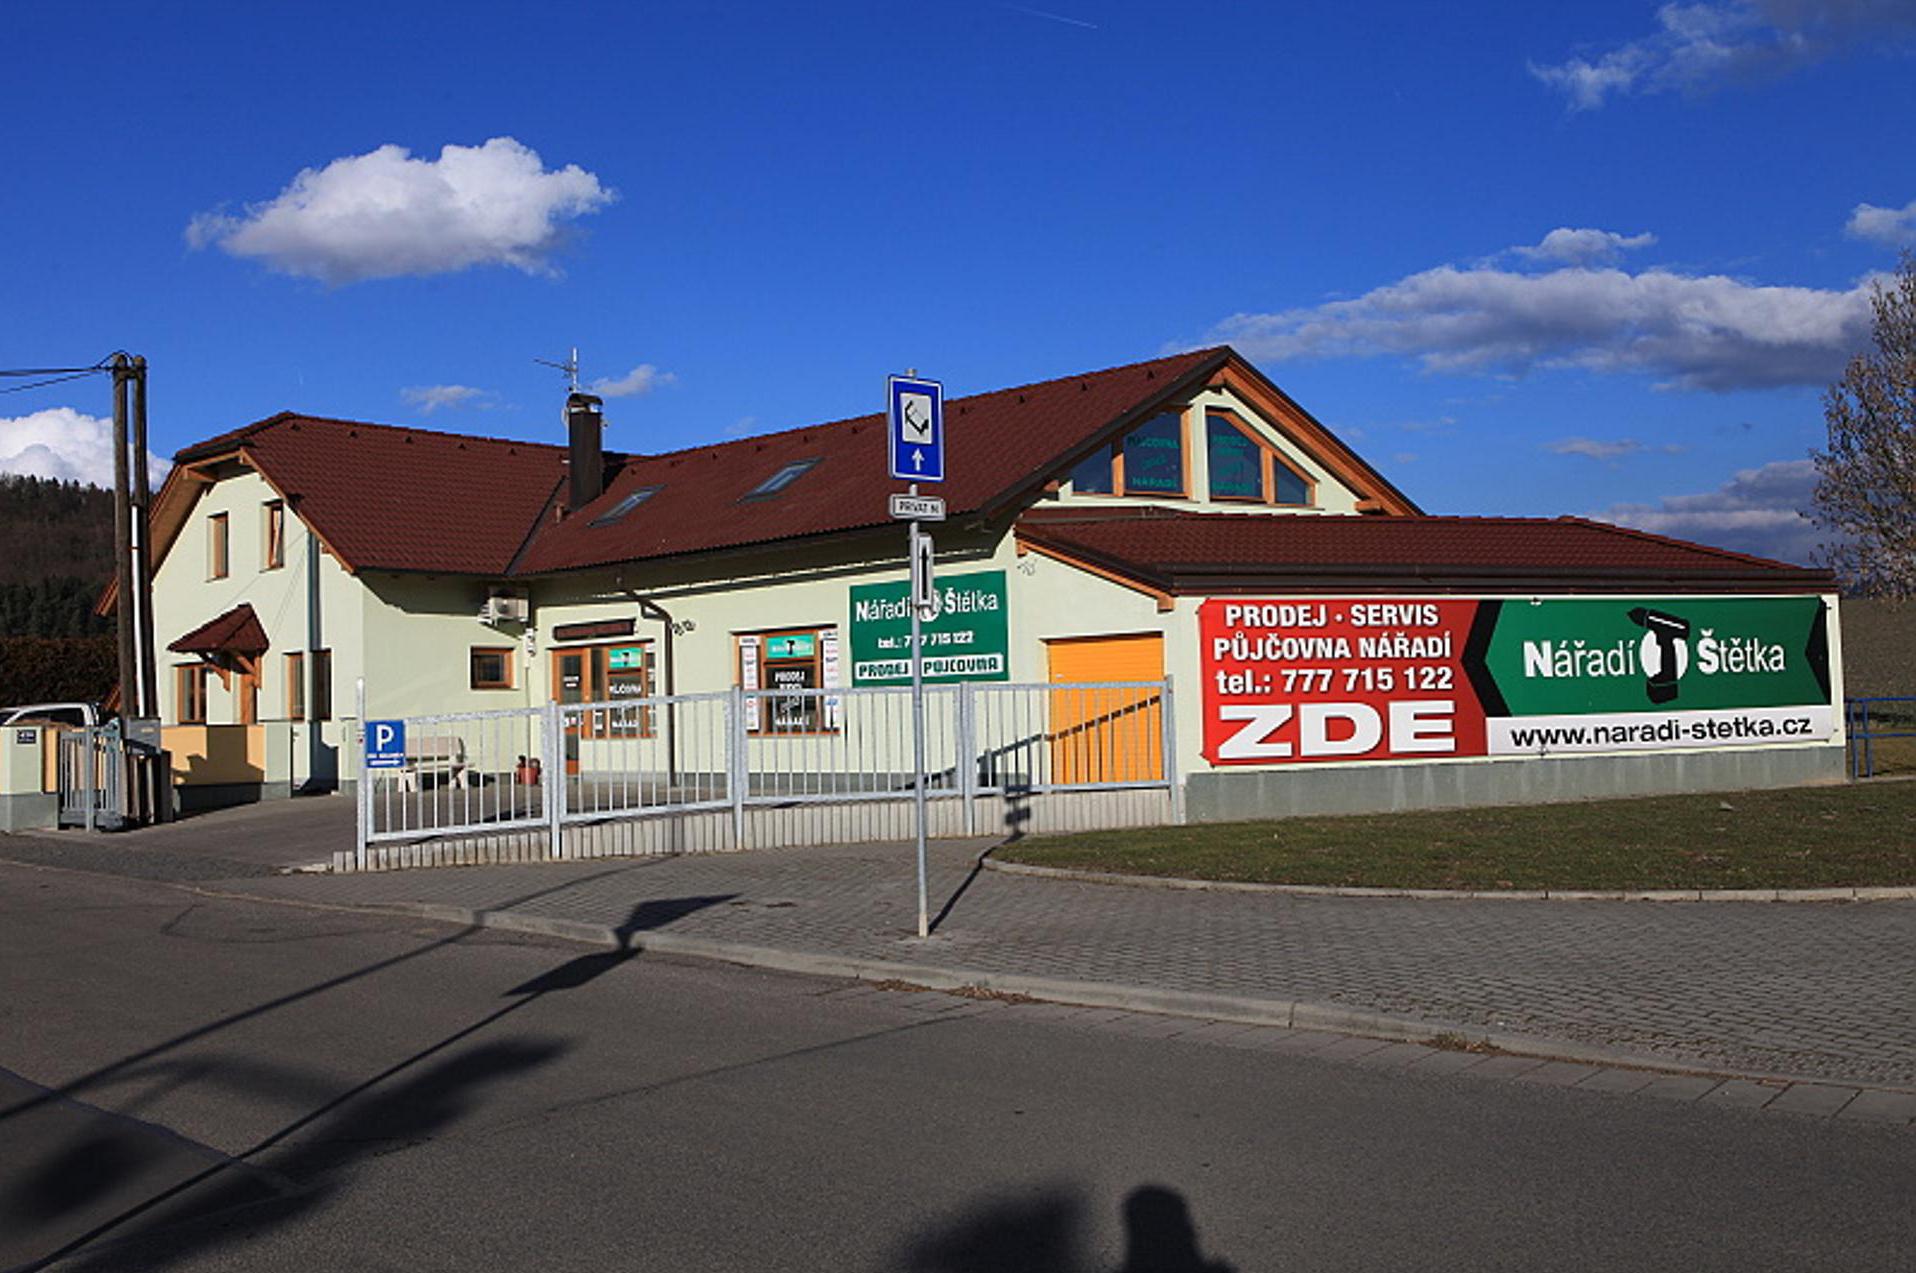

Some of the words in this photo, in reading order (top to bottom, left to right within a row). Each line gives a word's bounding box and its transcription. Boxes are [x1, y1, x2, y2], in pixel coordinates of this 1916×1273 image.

[944, 587, 999, 614] Štětka
[1225, 604, 1328, 628] PRODEJ
[1351, 603, 1439, 627] SERVIS
[904, 634, 927, 648] 77
[1213, 631, 1352, 662] PŮJČOVNA
[1359, 631, 1452, 660] NÁŘADÍ
[1523, 640, 1636, 678] Nářadí
[1696, 628, 1786, 675] Štětka
[858, 661, 909, 677] PRODEJ
[1215, 670, 1272, 694] tel.:
[1281, 669, 1335, 693] 777
[1343, 667, 1395, 692] 715
[1403, 667, 1453, 691] 122
[376, 724, 395, 751] P
[1217, 700, 1456, 760] ZDE
[1510, 716, 1814, 747] www.naradi-stetka.cz
